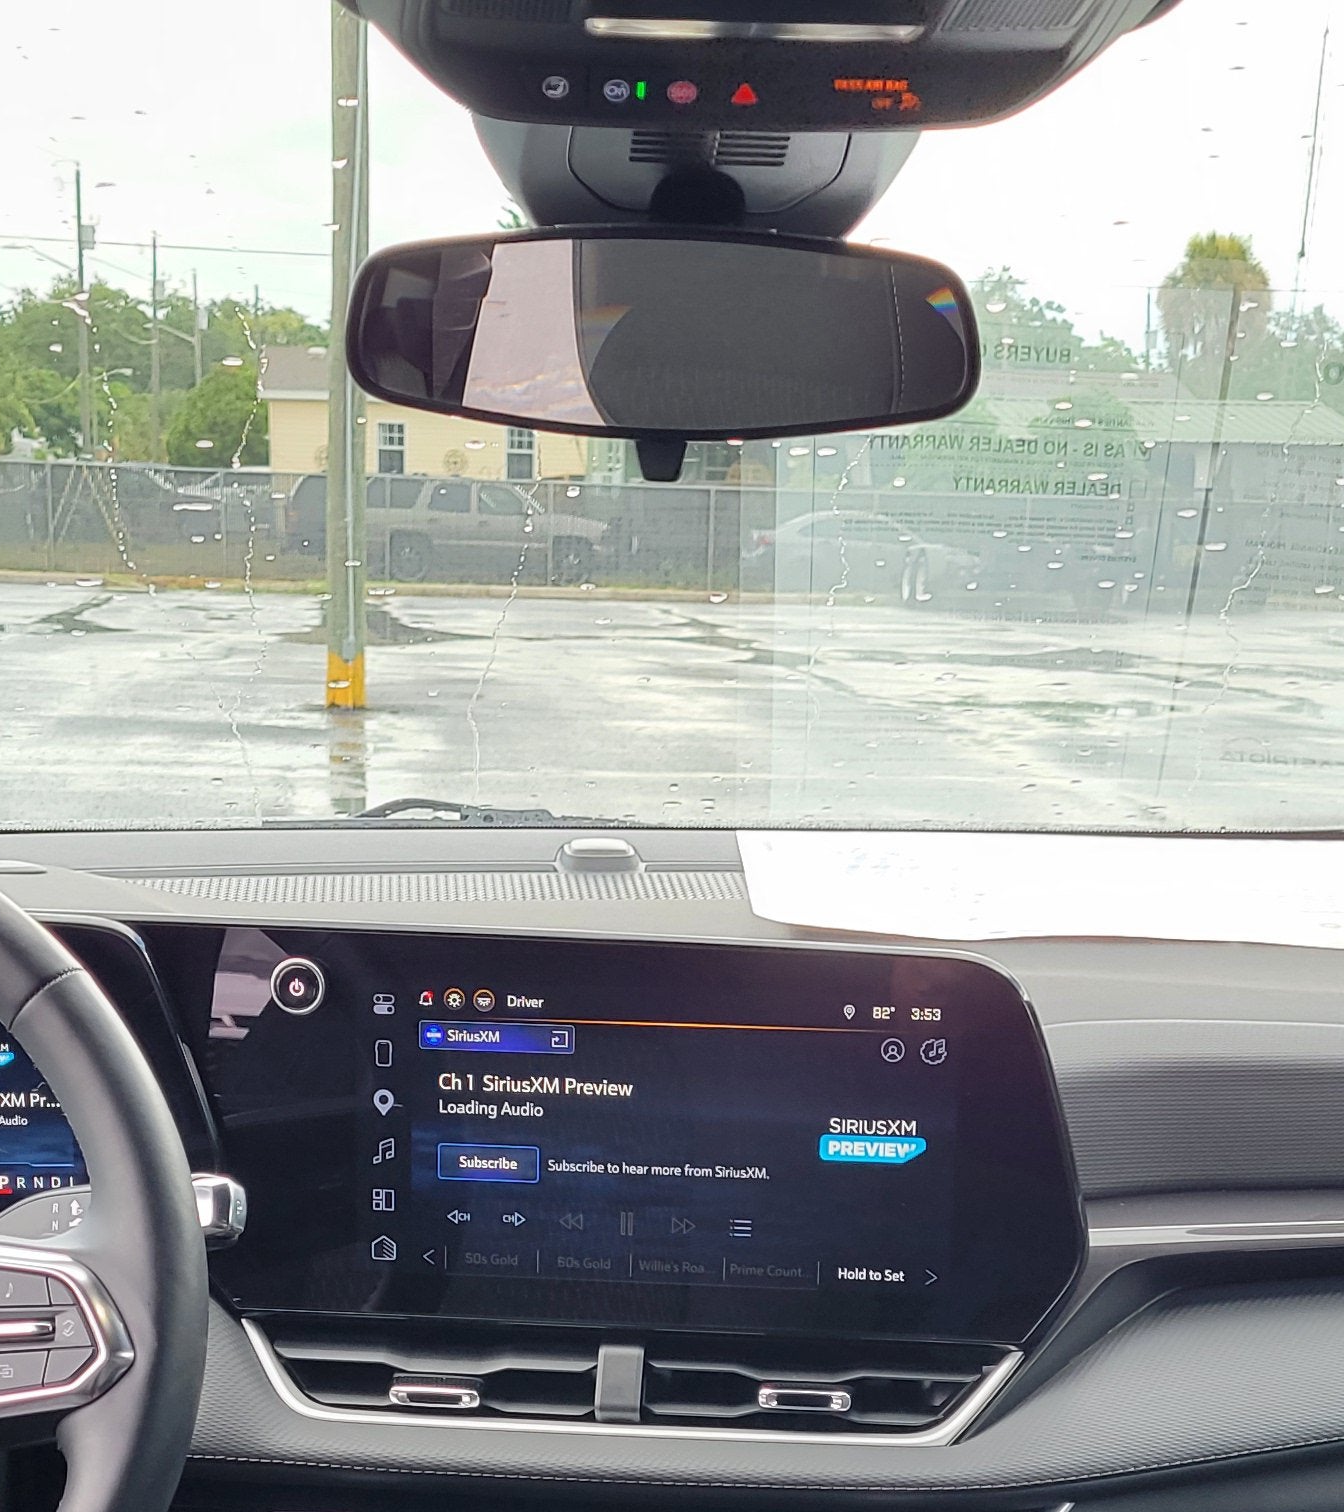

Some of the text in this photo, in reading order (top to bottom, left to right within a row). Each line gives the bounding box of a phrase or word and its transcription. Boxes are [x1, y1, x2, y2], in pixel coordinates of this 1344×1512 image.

[507, 995, 545, 1008] Driver
[872, 1006, 896, 1020] 82°
[910, 1007, 942, 1021] 3:53
[447, 1028, 500, 1043] SiriusXM
[438, 1073, 634, 1097] Ch 1 SiriusXM Preview
[30, 1093, 61, 1108] Pr...
[438, 1099, 544, 1119] Loading Audio
[829, 1117, 917, 1136] SIRIUSXM
[828, 1140, 917, 1158] PREVIEW
[459, 1155, 518, 1171] Subscribe
[547, 1159, 770, 1180] Subscribe to hear more from SiriusXM.
[17, 1177, 26, 1188] R
[33, 1177, 43, 1188] N
[51, 1176, 61, 1188] D
[458, 1212, 471, 1222] CH
[503, 1214, 514, 1223] CH
[464, 1254, 518, 1267] 50s Gold
[584, 1258, 611, 1270] Gold
[638, 1260, 680, 1273] Willie's
[729, 1263, 764, 1276] Prime
[838, 1267, 905, 1282] Hold to Set
